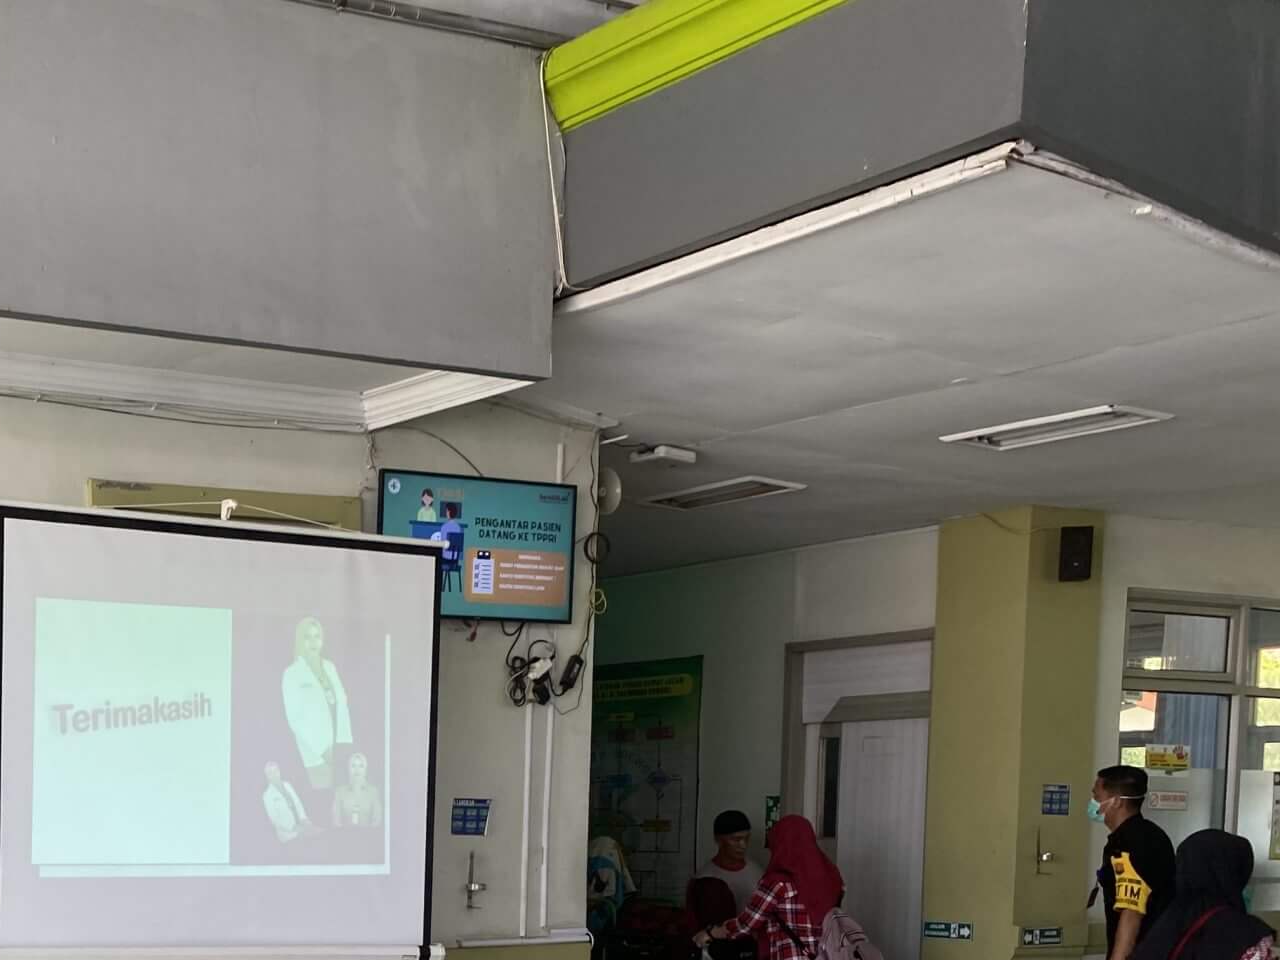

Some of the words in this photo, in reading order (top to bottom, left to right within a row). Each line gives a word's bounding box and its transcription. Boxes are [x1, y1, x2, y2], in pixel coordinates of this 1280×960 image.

[475, 517, 529, 531] PENGANTAR
[531, 521, 562, 534] PASIEN
[478, 529, 517, 541] DATANG
[518, 532, 529, 542] KE
[531, 533, 557, 544] TPPRI
[51, 692, 213, 736] Terimakasih
